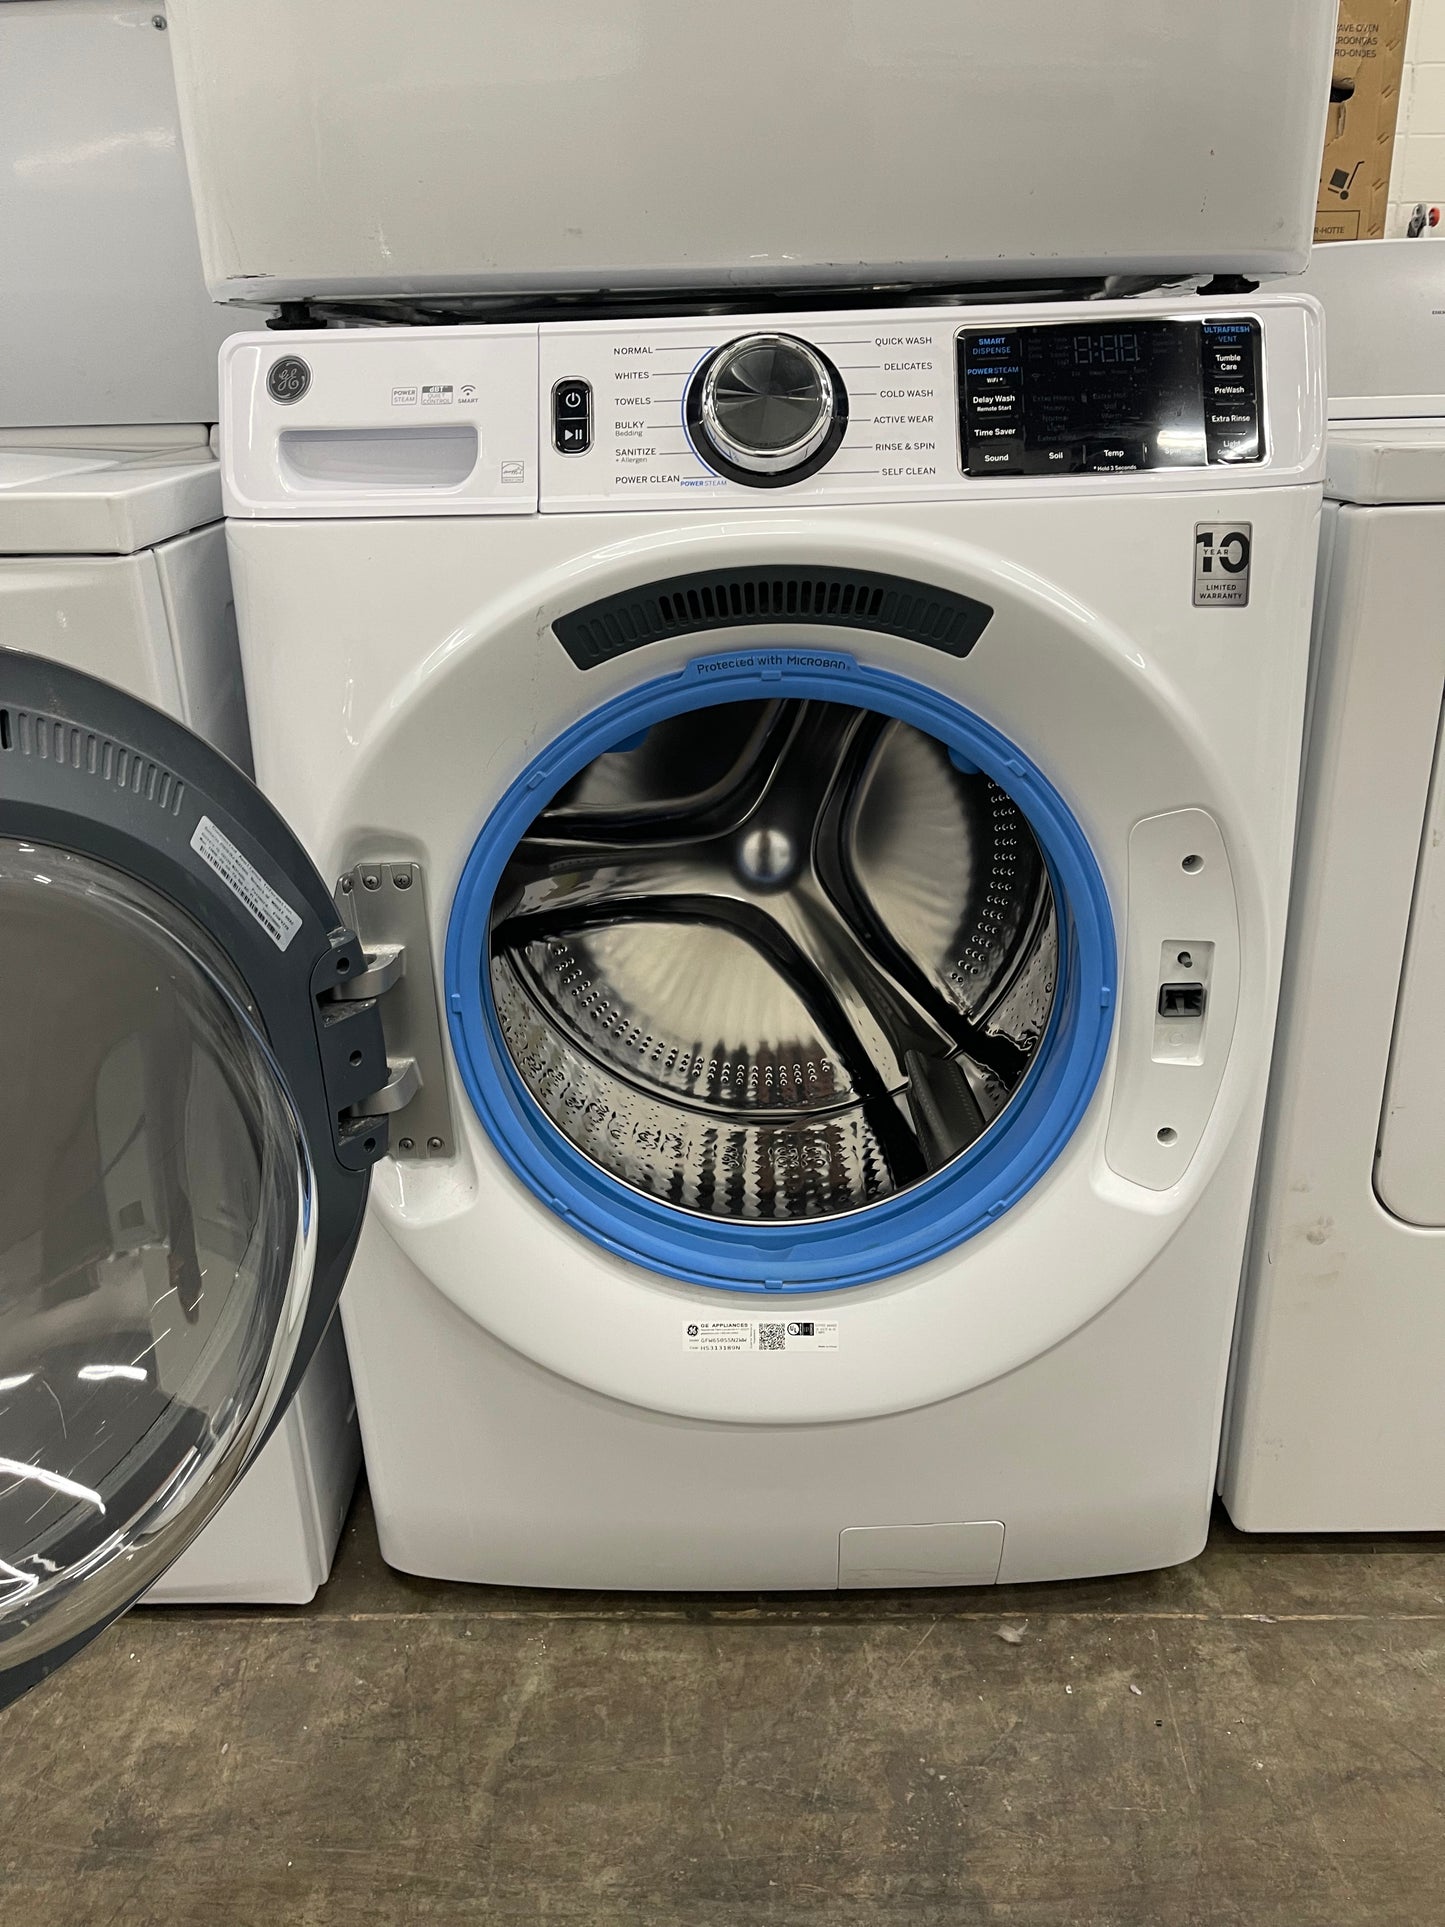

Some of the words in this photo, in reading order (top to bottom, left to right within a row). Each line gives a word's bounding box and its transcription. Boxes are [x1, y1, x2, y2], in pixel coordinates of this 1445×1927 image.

[1337, 24, 1353, 32] AVE
[1336, 36, 1377, 45] ROONDAS
[875, 338, 903, 346] QUICK
[979, 337, 1005, 345] SMART
[973, 346, 1010, 355] DISPENSE
[884, 362, 932, 370] DELICATES
[973, 396, 993, 404] Delay
[616, 421, 644, 429] BULKY
[616, 448, 656, 456] SANITIZE
[1104, 450, 1124, 458] Temp
[984, 454, 1009, 462] Sound
[616, 476, 647, 484] POWER
[650, 475, 680, 483] CLEAN
[1196, 532, 1249, 573] 10
[697, 658, 754, 674] Protected
[758, 656, 782, 665] with
